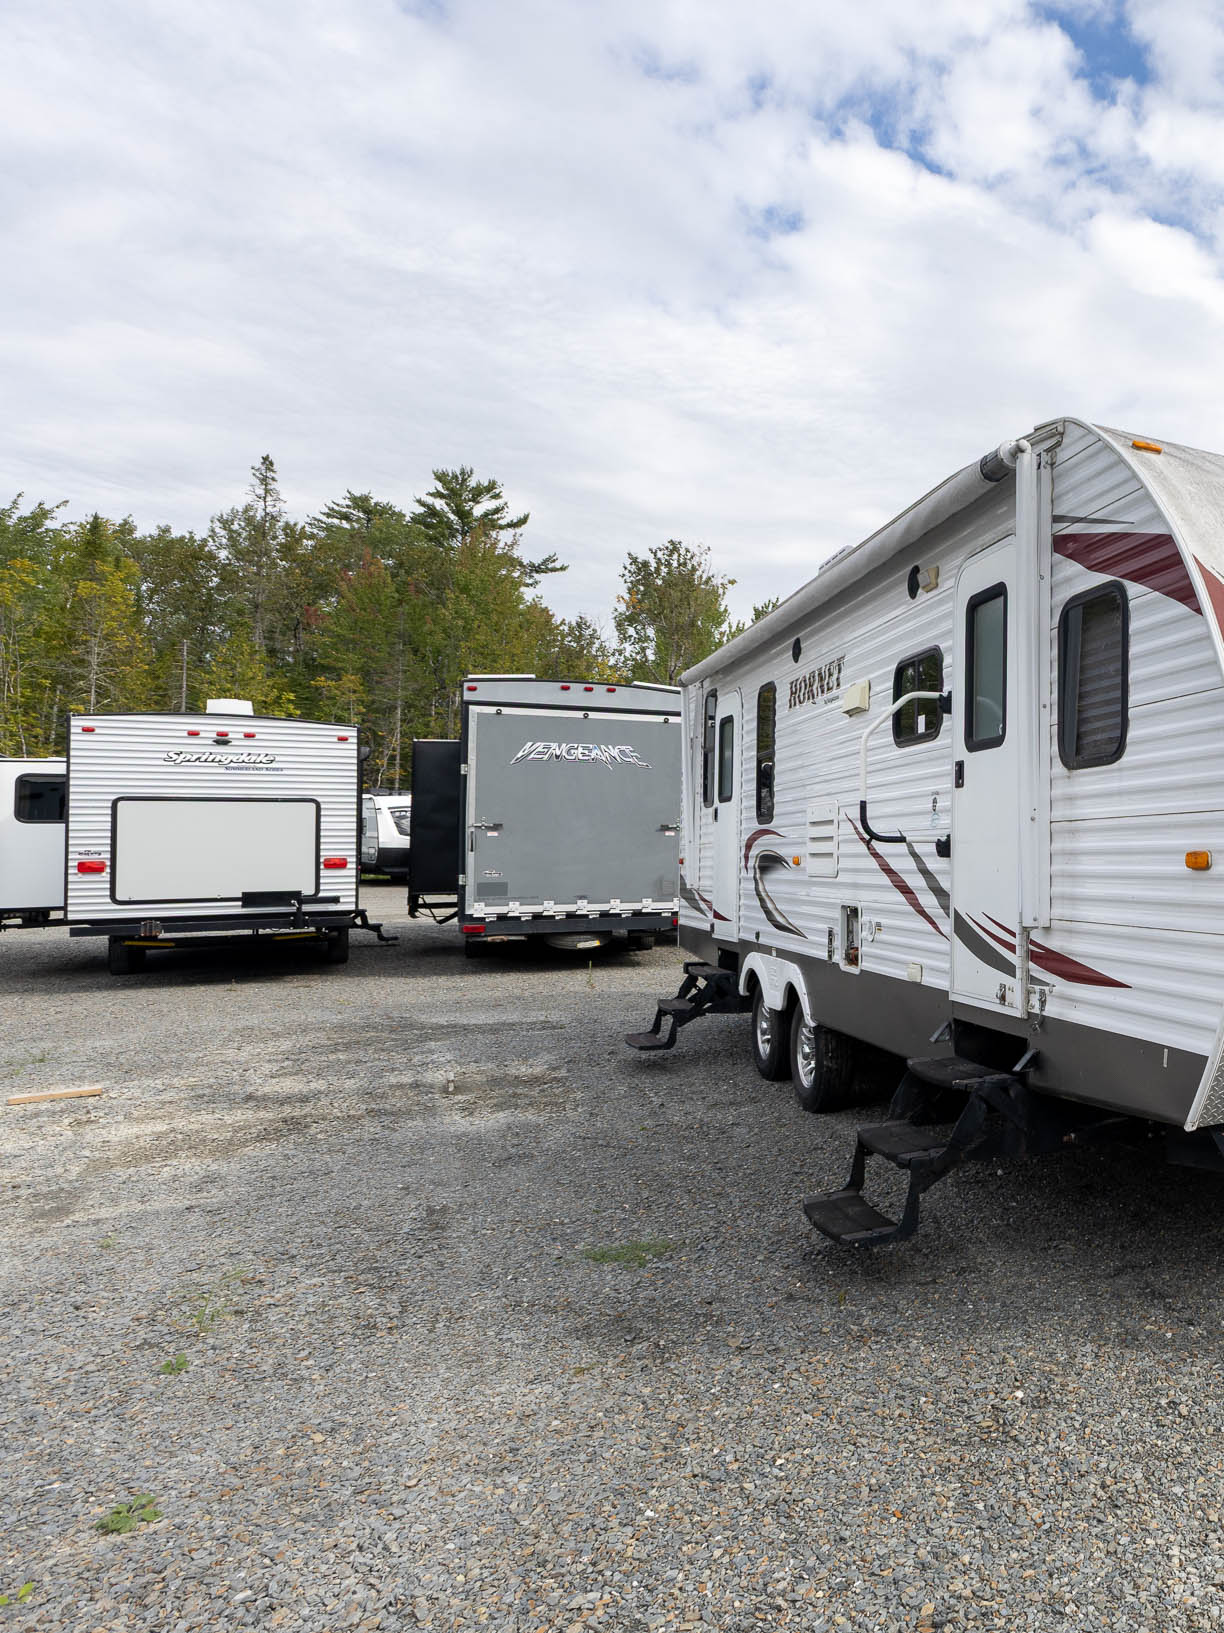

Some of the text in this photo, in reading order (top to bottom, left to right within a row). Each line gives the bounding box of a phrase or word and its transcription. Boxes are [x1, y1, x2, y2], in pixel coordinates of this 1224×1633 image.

[788, 654, 846, 710] HORNET
[163, 751, 276, 765] Springdale
[510, 741, 652, 770] VENGEANCE
